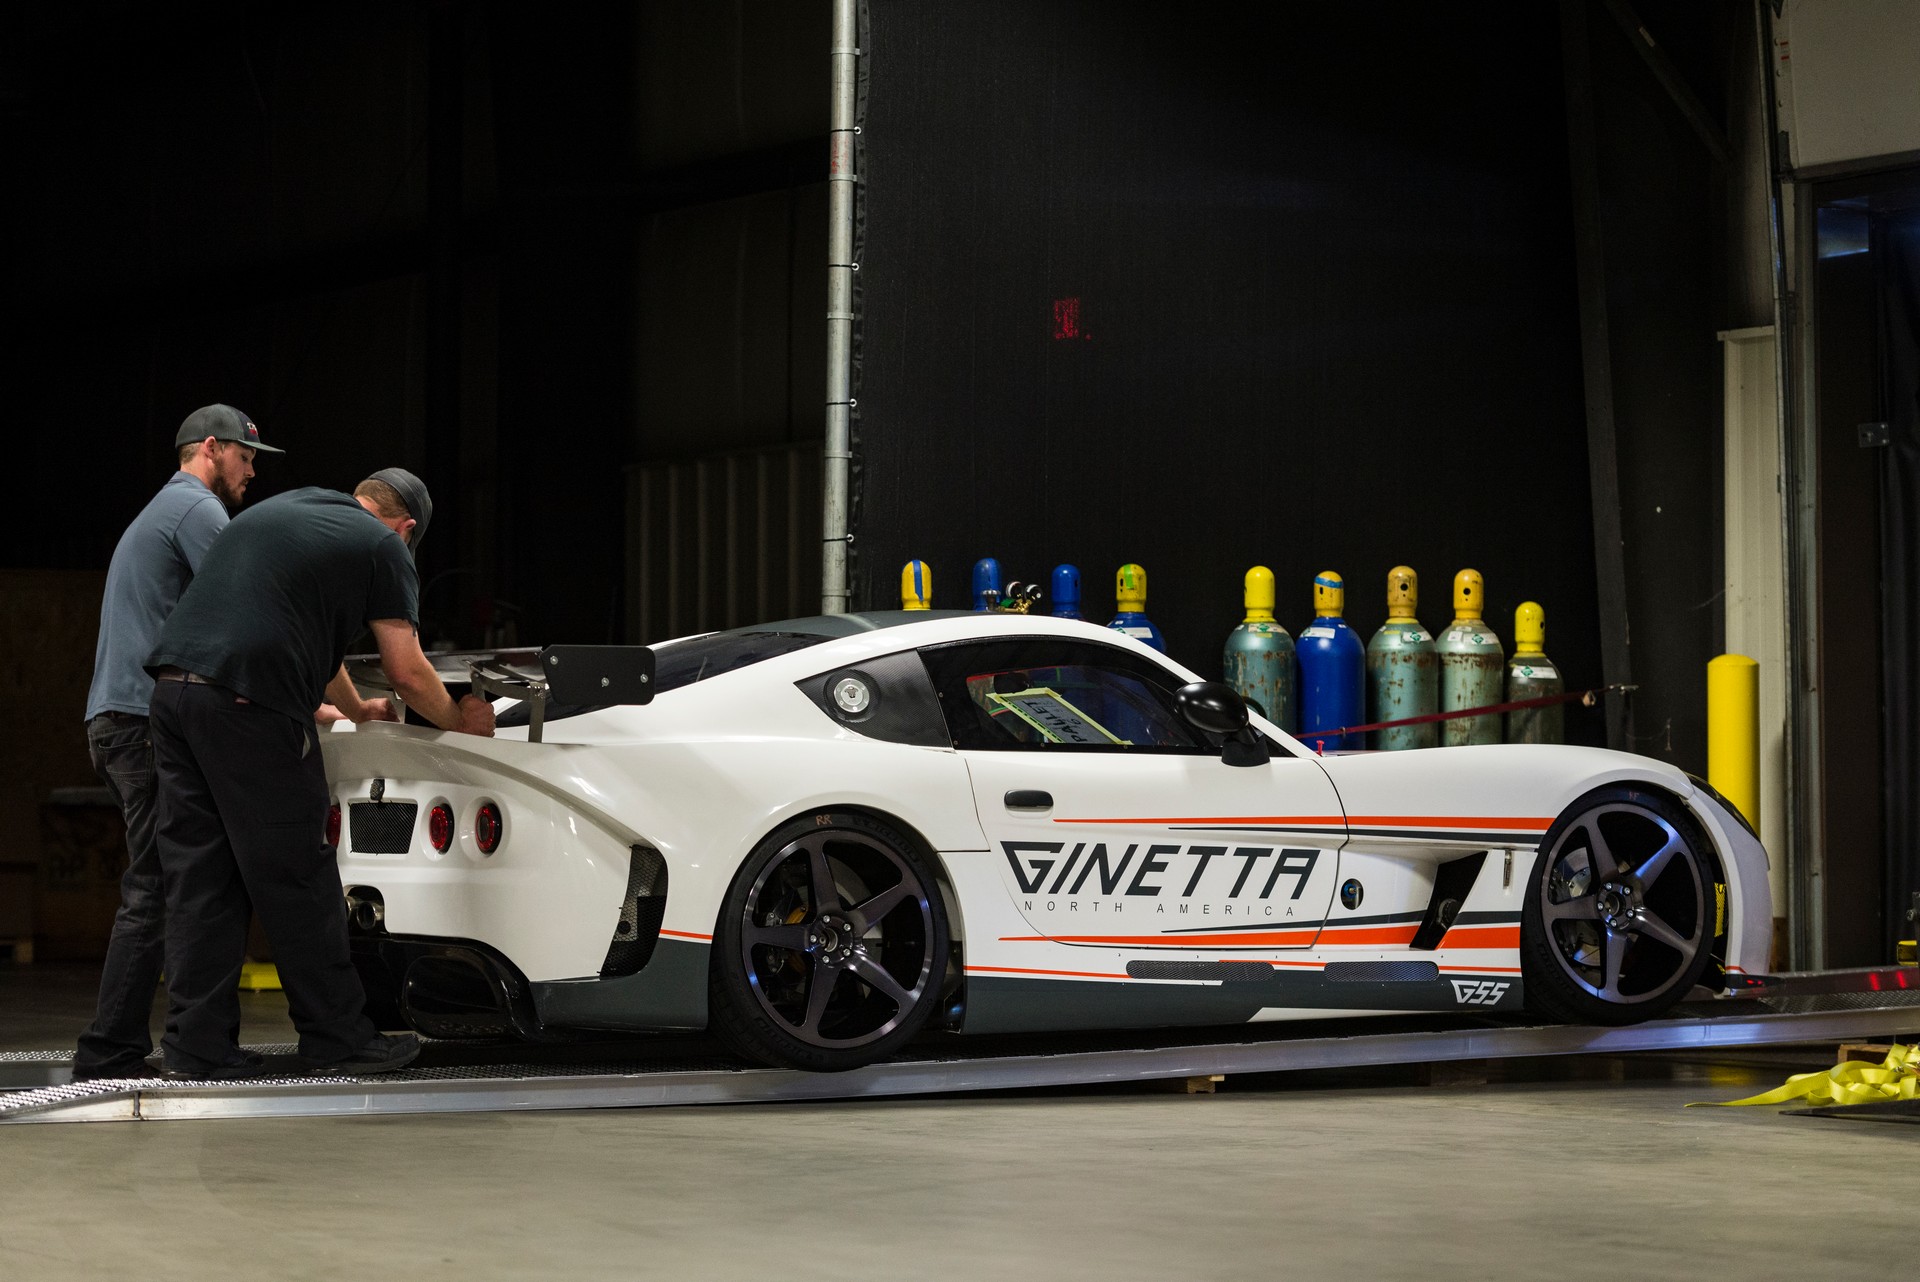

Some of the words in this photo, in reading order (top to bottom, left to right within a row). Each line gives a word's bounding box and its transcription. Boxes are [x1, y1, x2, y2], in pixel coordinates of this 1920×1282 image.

[1022, 700, 1088, 742] PALLET
[815, 814, 833, 826] RR
[1000, 841, 1321, 899] GINETTA
[1024, 901, 1122, 913] NORTH
[1156, 903, 1294, 916] AMERICA
